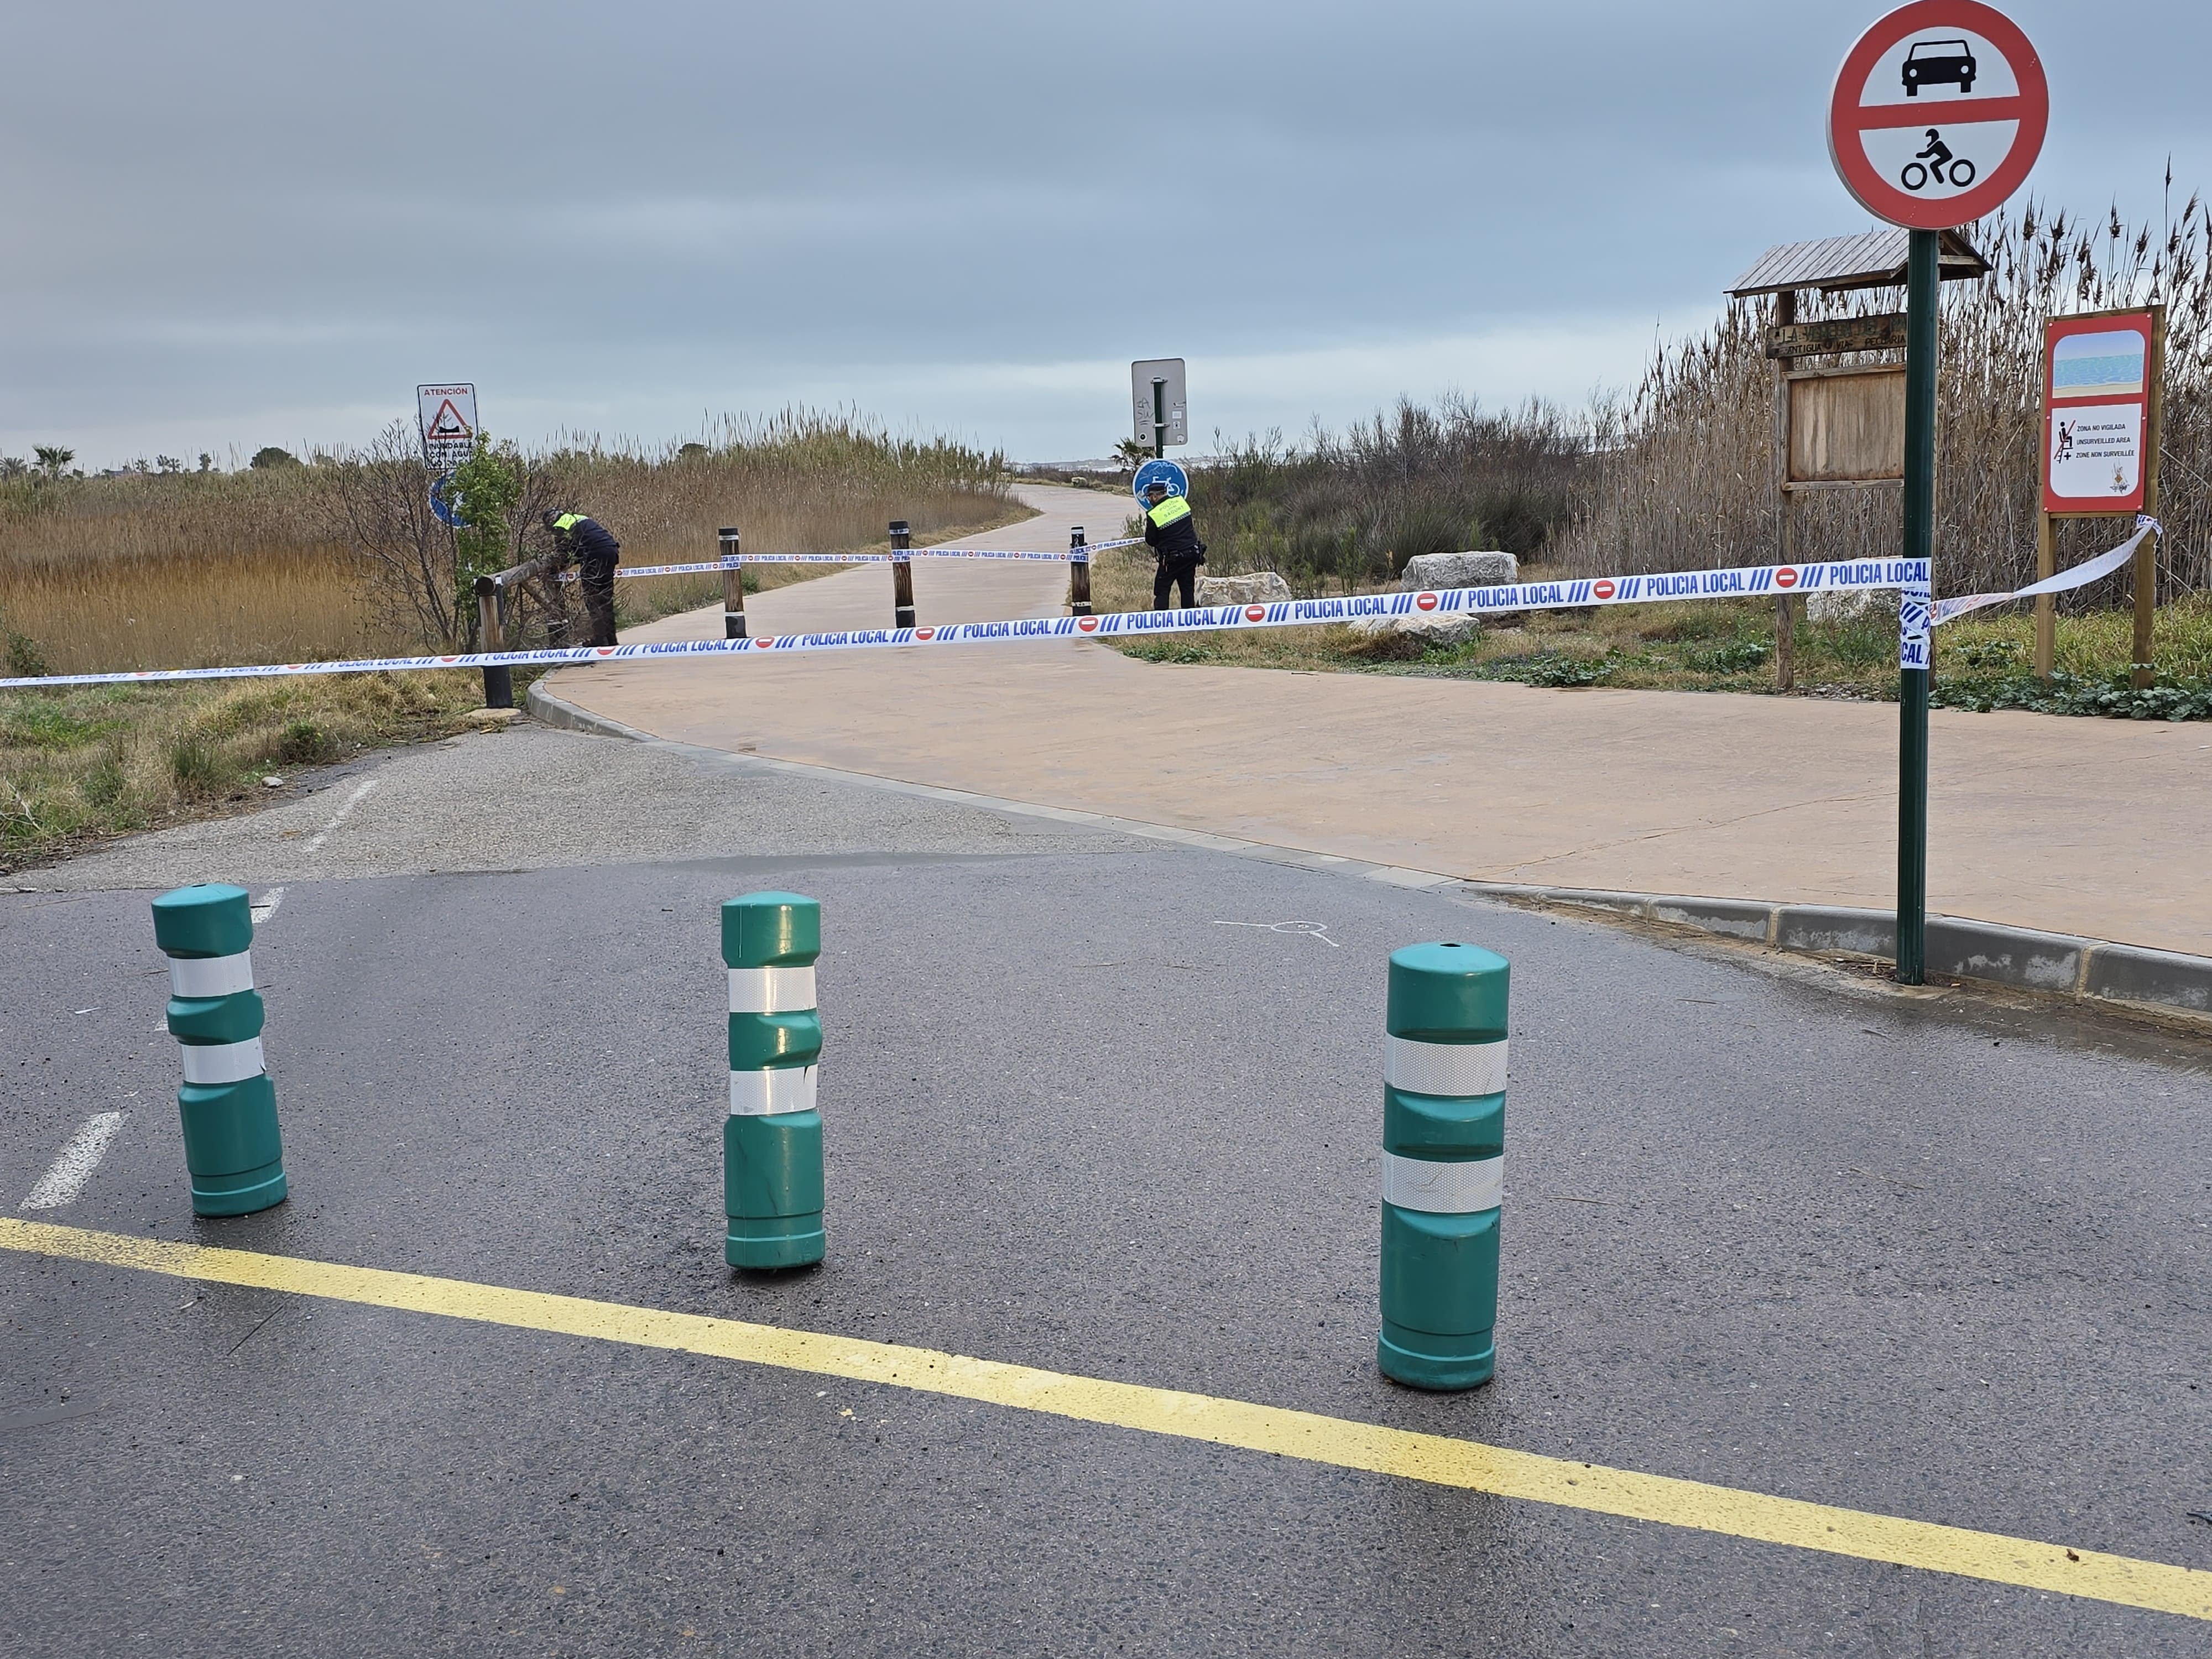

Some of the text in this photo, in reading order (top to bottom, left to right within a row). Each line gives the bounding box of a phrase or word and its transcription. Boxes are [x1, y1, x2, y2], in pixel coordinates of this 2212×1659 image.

[1787, 343, 1823, 354] ANTIGUA
[1865, 334, 1907, 347] PECUARIA
[424, 387, 468, 396] ATENCIÓN
[2103, 449, 2135, 457] SURVEILLÉE
[642, 641, 687, 654] POLICIA
[691, 639, 728, 651] LOCAL
[802, 632, 847, 646] POLICIA
[851, 629, 889, 644] LOCAL
[963, 623, 1009, 638] POLICIA
[1013, 620, 1052, 636] LOCAL
[1126, 612, 1174, 630] POLICIA
[1178, 609, 1217, 627] LOCAL
[1295, 600, 1343, 620] POLICIA
[1347, 597, 1388, 617] LOCAL
[1468, 587, 1518, 608] POLICIA
[1522, 585, 1564, 604] LOCAL
[1647, 575, 1698, 596] POLICIA
[1703, 572, 1745, 593] LOCAL
[1830, 563, 1882, 585] POLICIA
[1887, 562, 1929, 583] LOCAL
